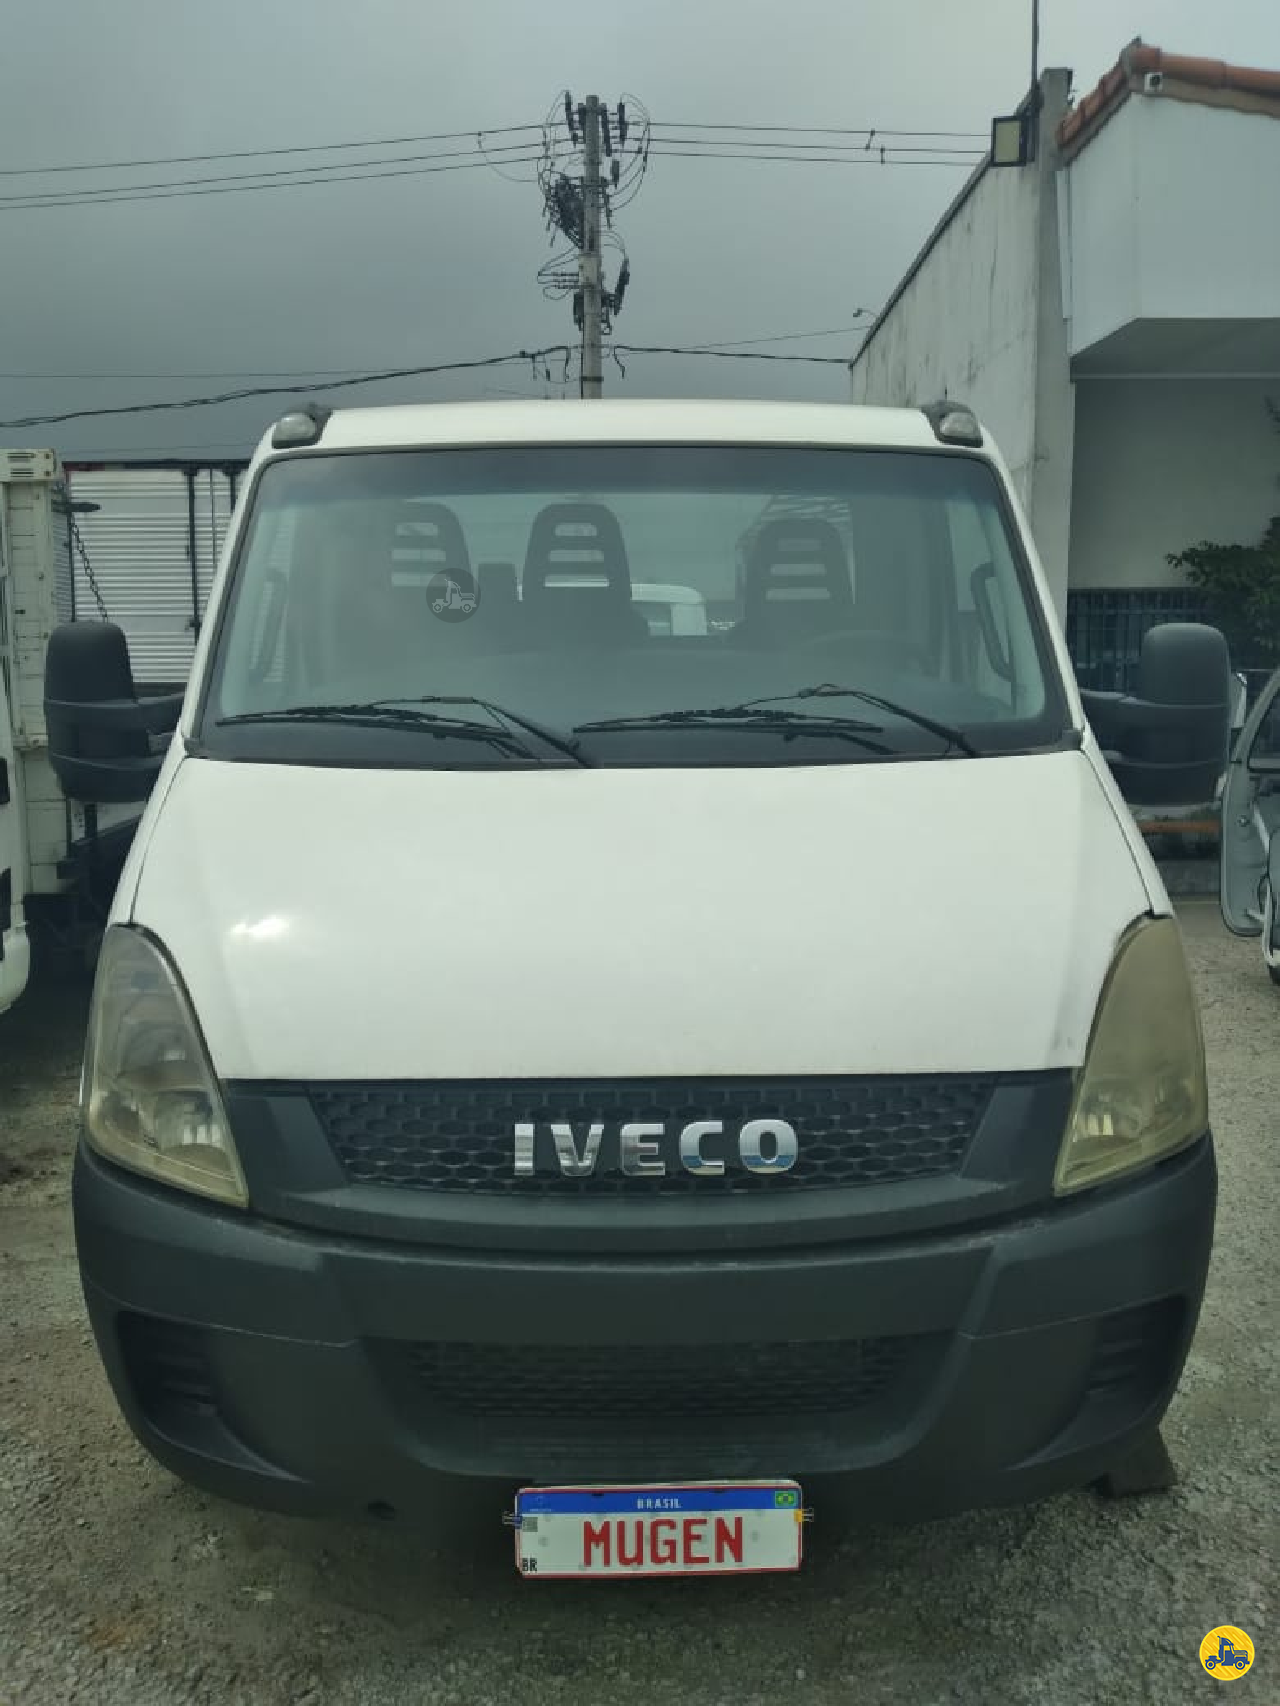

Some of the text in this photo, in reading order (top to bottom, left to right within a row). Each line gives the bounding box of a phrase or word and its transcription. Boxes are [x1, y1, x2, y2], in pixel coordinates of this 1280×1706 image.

[514, 1118, 798, 1177] IVECO
[637, 1498, 682, 1509] BRASIL
[583, 1516, 743, 1568] MUGEN
[521, 1557, 538, 1572] BR
